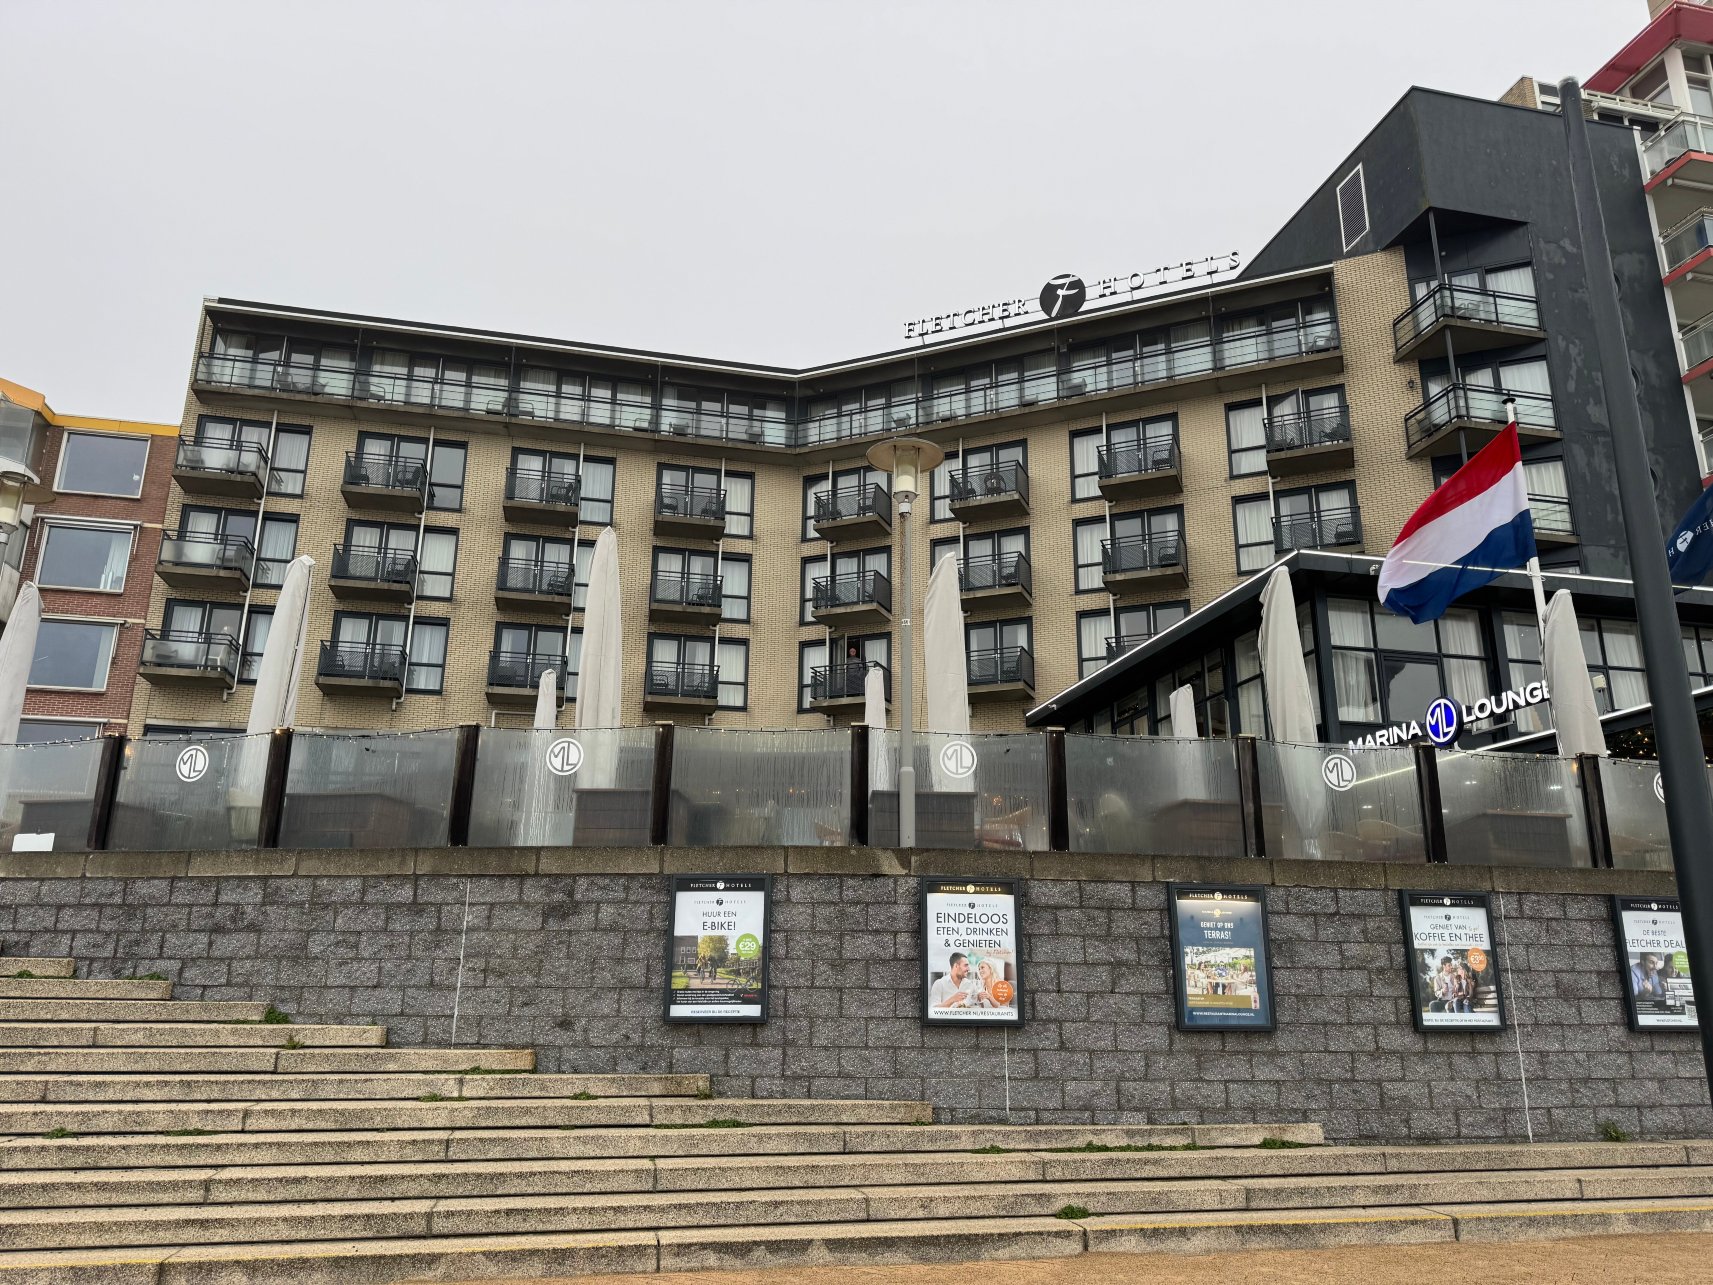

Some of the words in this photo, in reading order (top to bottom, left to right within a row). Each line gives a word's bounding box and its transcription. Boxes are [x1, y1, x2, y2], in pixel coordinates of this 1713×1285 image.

[903, 298, 1029, 339] FLETCHER
[1098, 249, 1241, 298] HOTELS
[1348, 720, 1422, 755] MARINA
[702, 910, 721, 918] HUUR
[723, 910, 737, 918] EEN
[936, 912, 1009, 925] EINDELOOS
[702, 921, 736, 931] E-BIKE!
[1429, 923, 1452, 931] GENIET
[1454, 923, 1467, 931] VAN
[936, 926, 962, 937] ETEN,
[965, 927, 1009, 937] DRINKEN
[1203, 930, 1232, 940] TERRAS!
[1651, 929, 1667, 937] BESTE
[1414, 932, 1445, 942] KOFFIE
[1448, 932, 1462, 942] EN
[1464, 933, 1485, 943] THEE
[739, 941, 756, 951] €29
[943, 938, 951, 948] &
[953, 938, 1002, 948] GENIETEN
